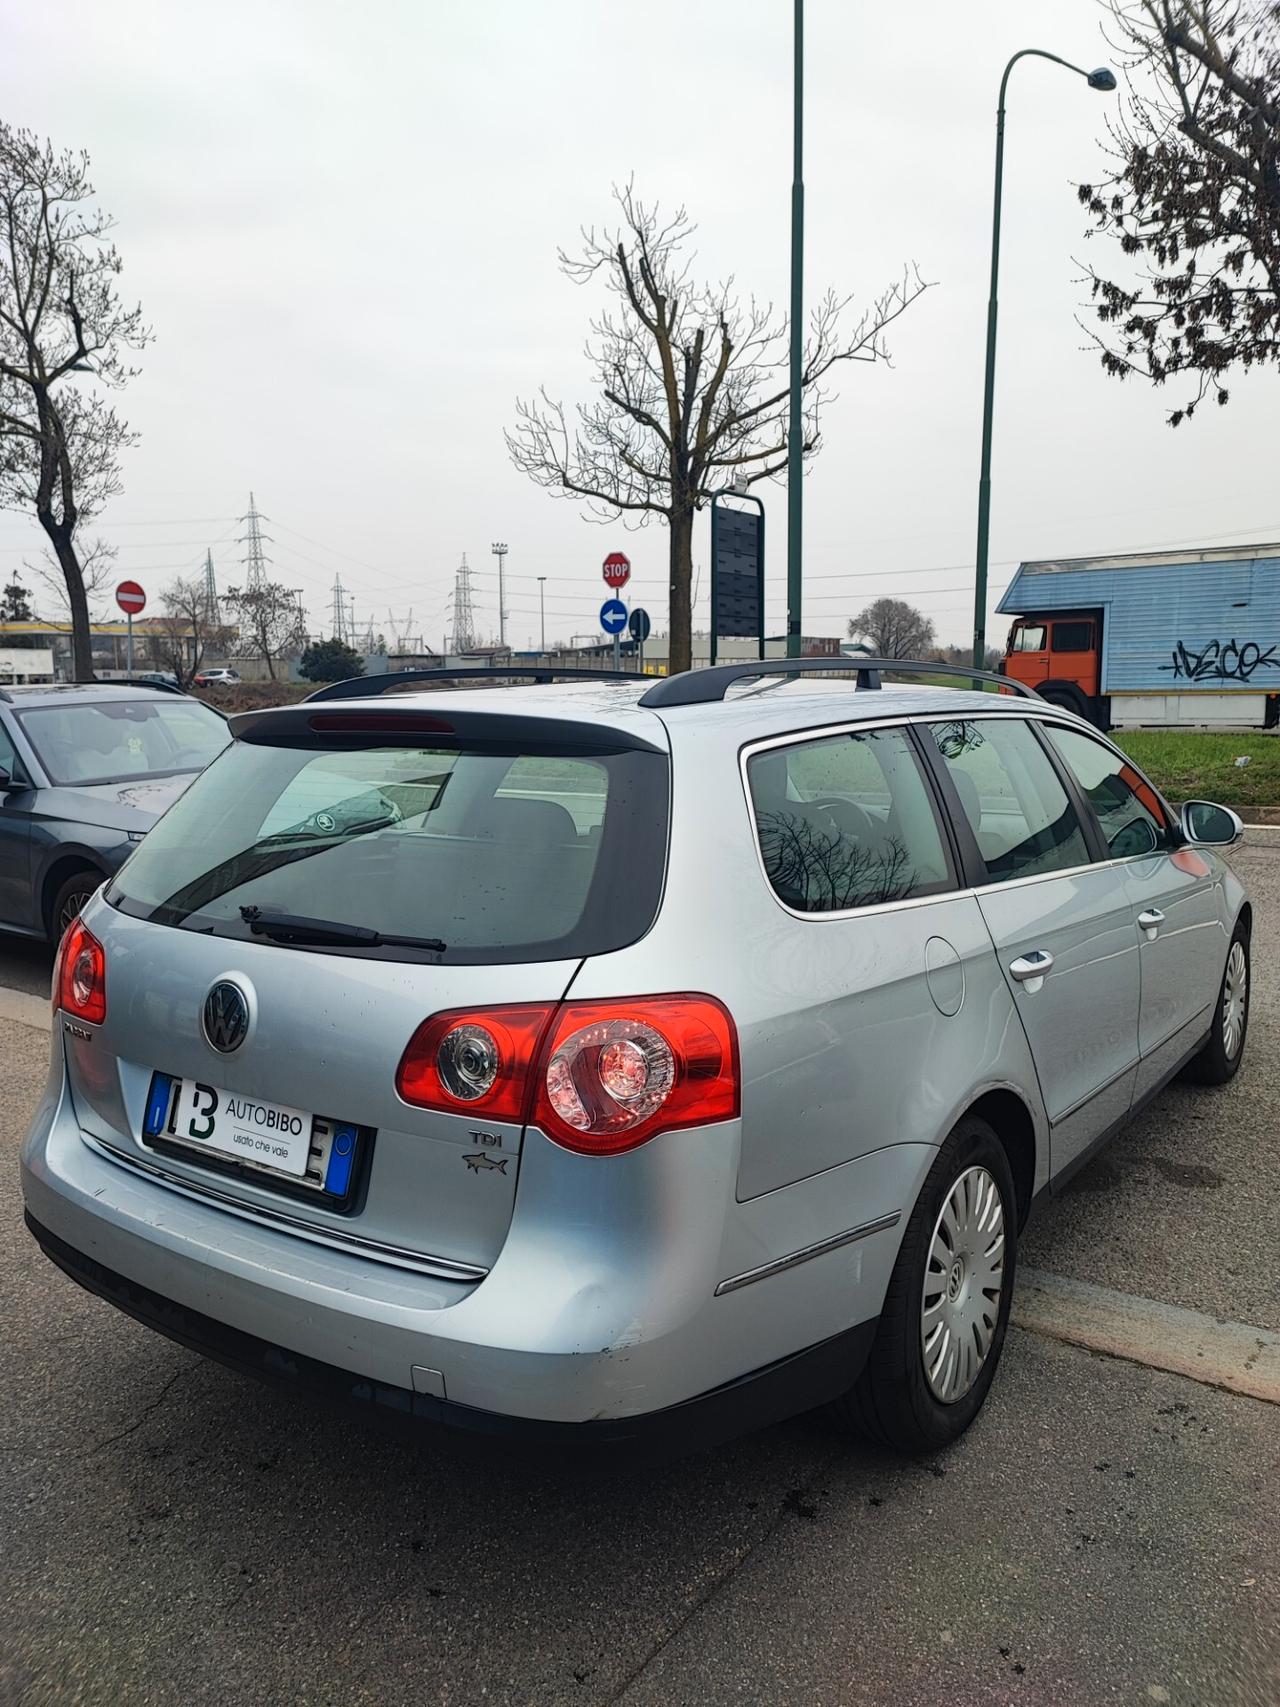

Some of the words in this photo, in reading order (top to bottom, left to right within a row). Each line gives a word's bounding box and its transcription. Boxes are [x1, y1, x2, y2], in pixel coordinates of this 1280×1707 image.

[604, 564, 628, 578] STOP
[225, 1098, 303, 1136] AUTOBIBO
[232, 1132, 254, 1148] usato
[255, 1138, 271, 1152] che
[271, 1144, 289, 1159] vale
[467, 1129, 502, 1148] TDI
